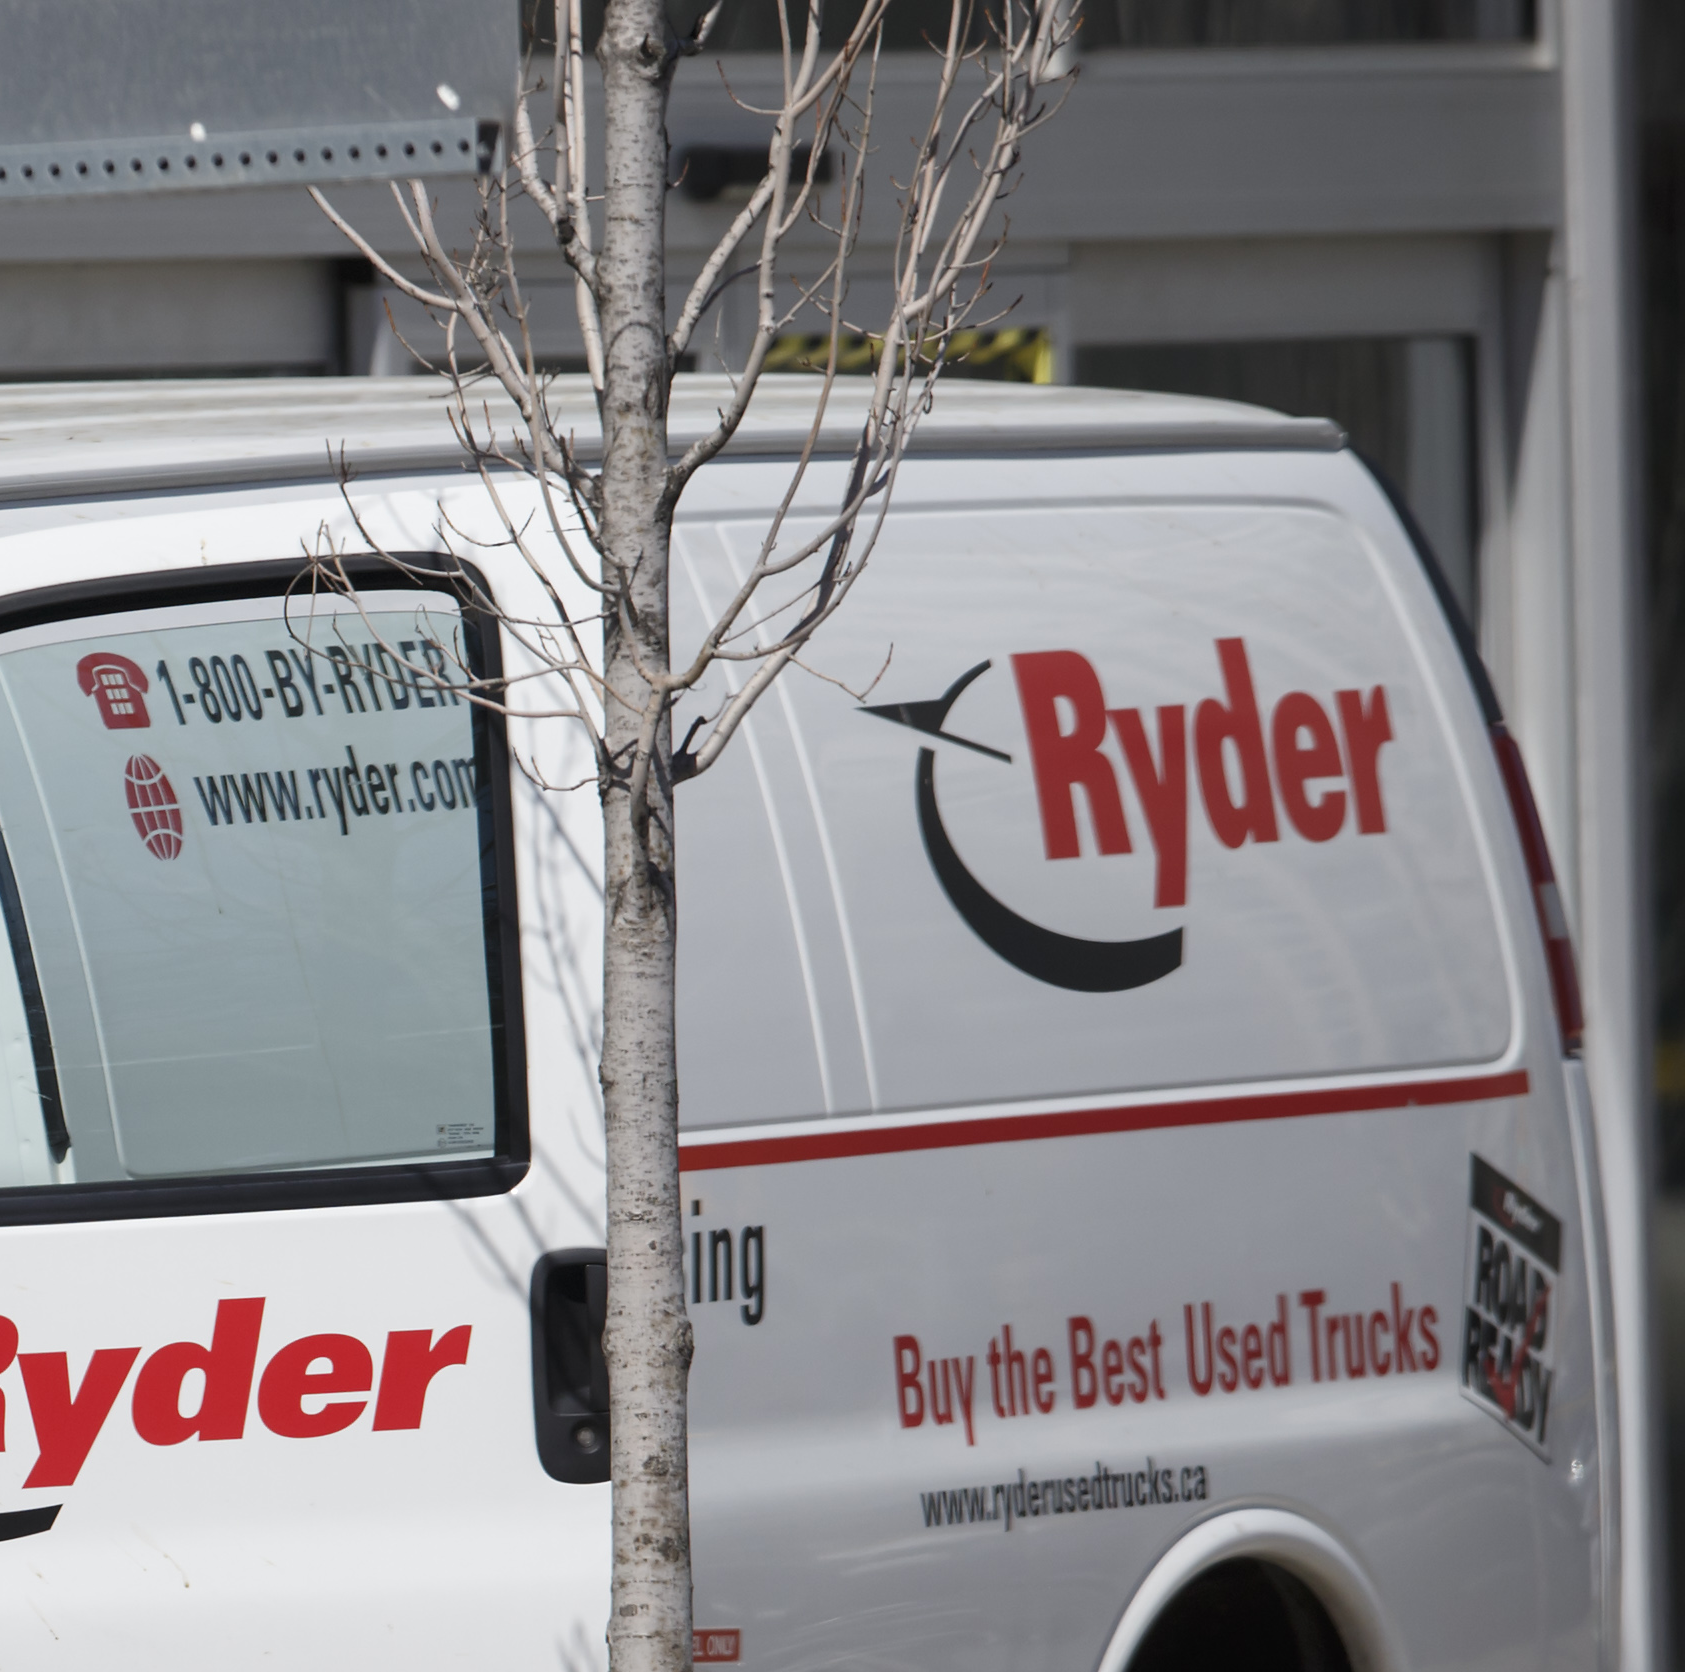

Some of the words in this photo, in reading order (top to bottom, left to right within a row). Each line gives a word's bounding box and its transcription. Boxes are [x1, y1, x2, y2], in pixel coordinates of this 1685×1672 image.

[156, 638, 461, 726] 1-800-BY-RYDER
[1010, 637, 1395, 910] Ryder
[893, 1332, 977, 1447] Buy
[986, 1323, 1056, 1418] the
[1066, 1314, 1167, 1410] Best
[1183, 1292, 1292, 1397] Used
[1298, 1280, 1442, 1383] Trucks
[921, 1456, 1210, 1532] www.ryderusedtrucks.ca
